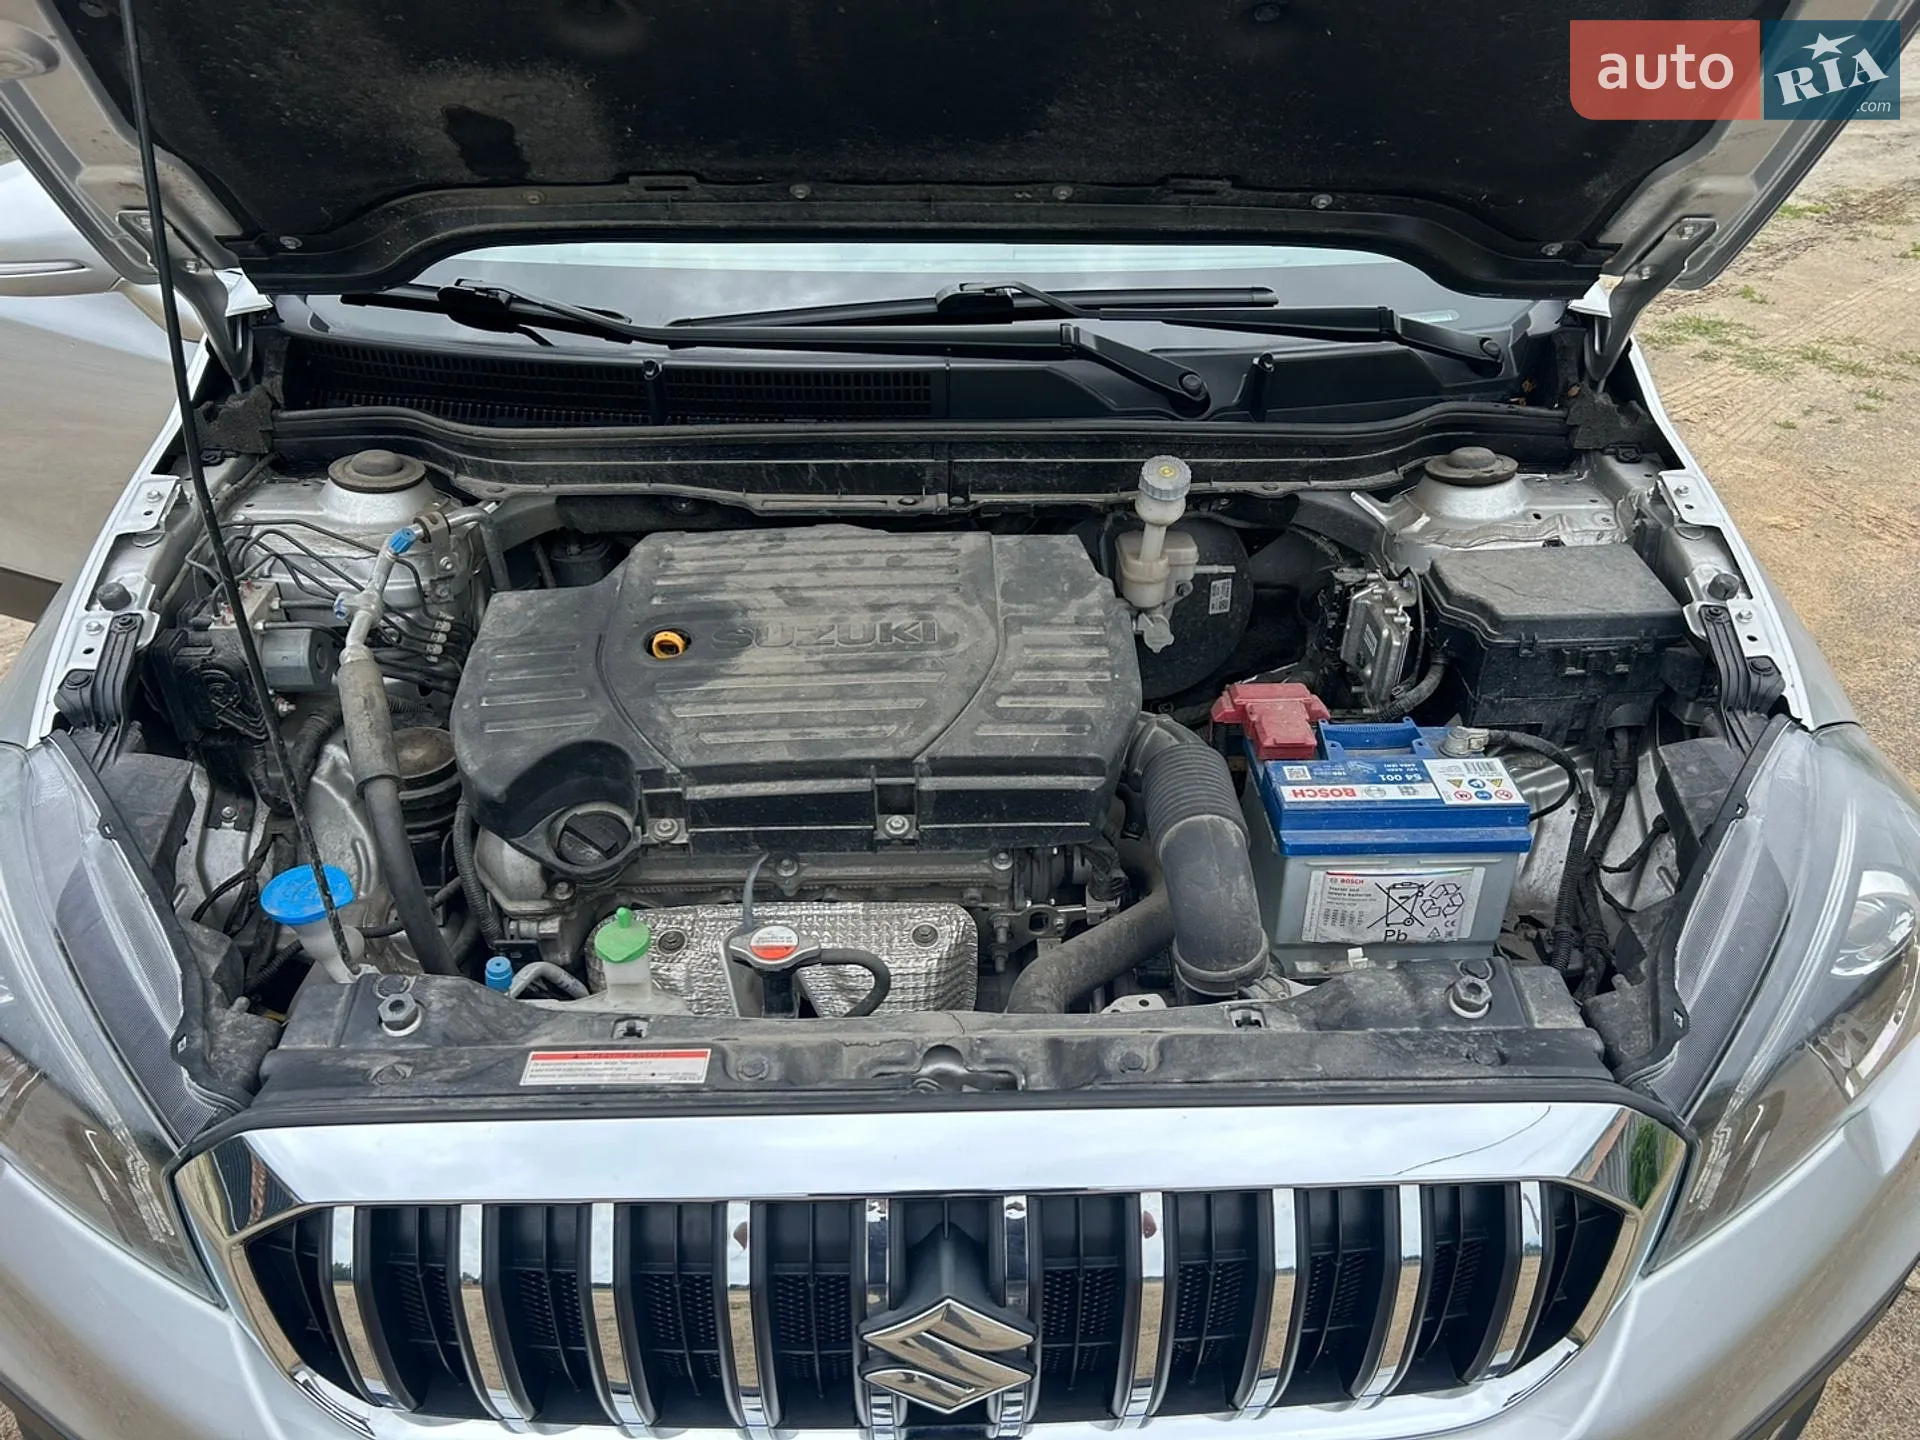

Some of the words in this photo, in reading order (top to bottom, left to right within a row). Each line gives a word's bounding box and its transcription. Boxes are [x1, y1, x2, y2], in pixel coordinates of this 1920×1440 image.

[712, 620, 938, 649] SUZUKI
[1291, 787, 1357, 798] BOSCH
[1383, 929, 1409, 942] Pb
